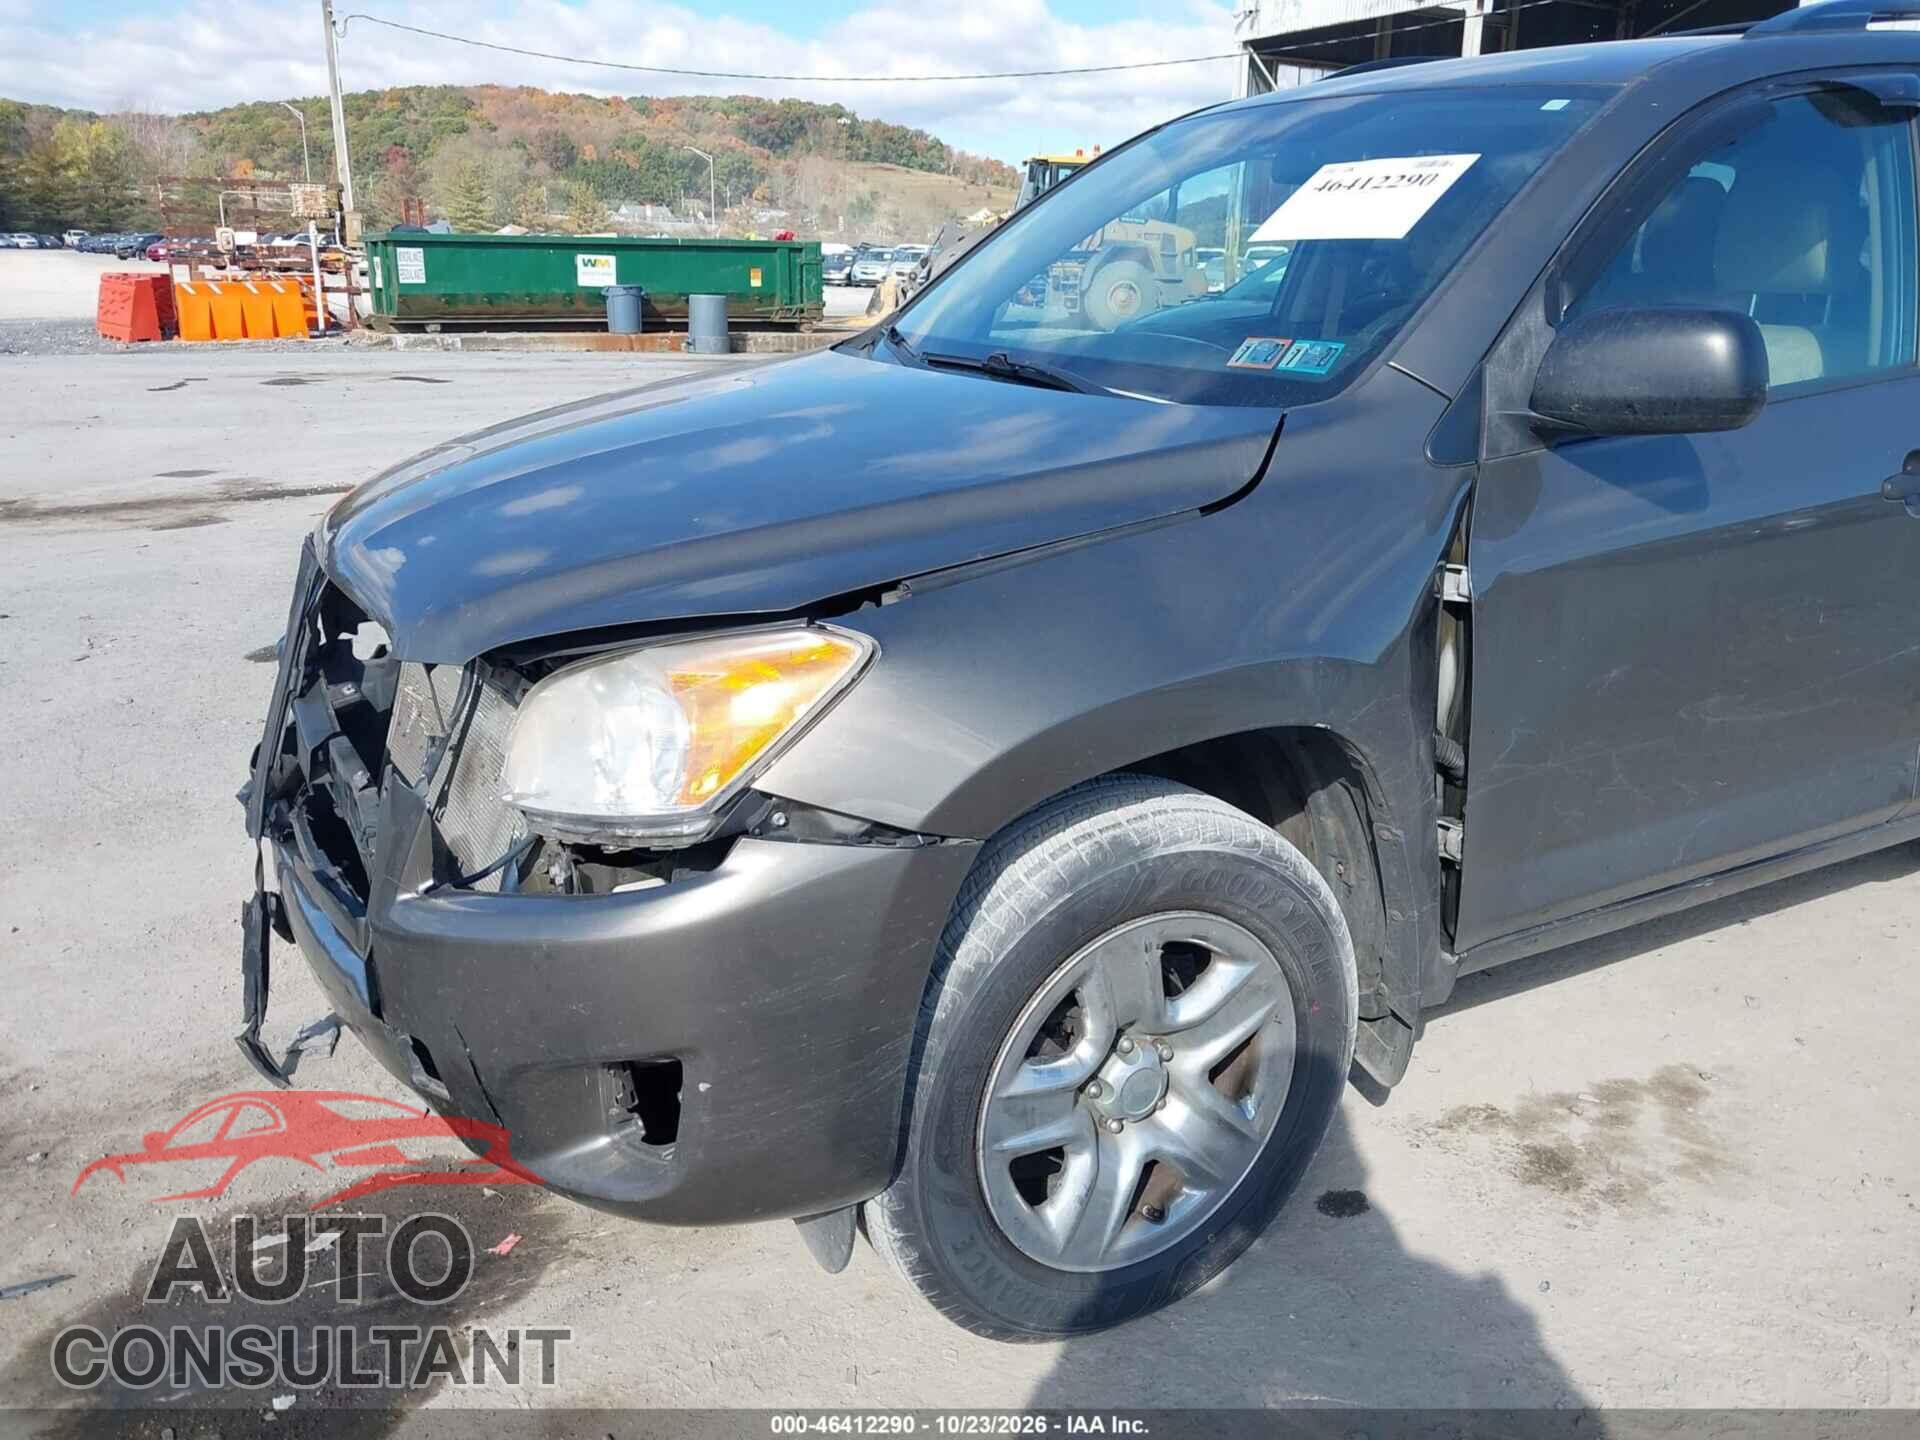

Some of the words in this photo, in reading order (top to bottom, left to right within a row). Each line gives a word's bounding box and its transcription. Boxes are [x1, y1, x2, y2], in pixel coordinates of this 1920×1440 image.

[1314, 173, 1439, 192] 46412290
[582, 257, 611, 269] WM
[1180, 867, 1333, 984] GOODYEAR
